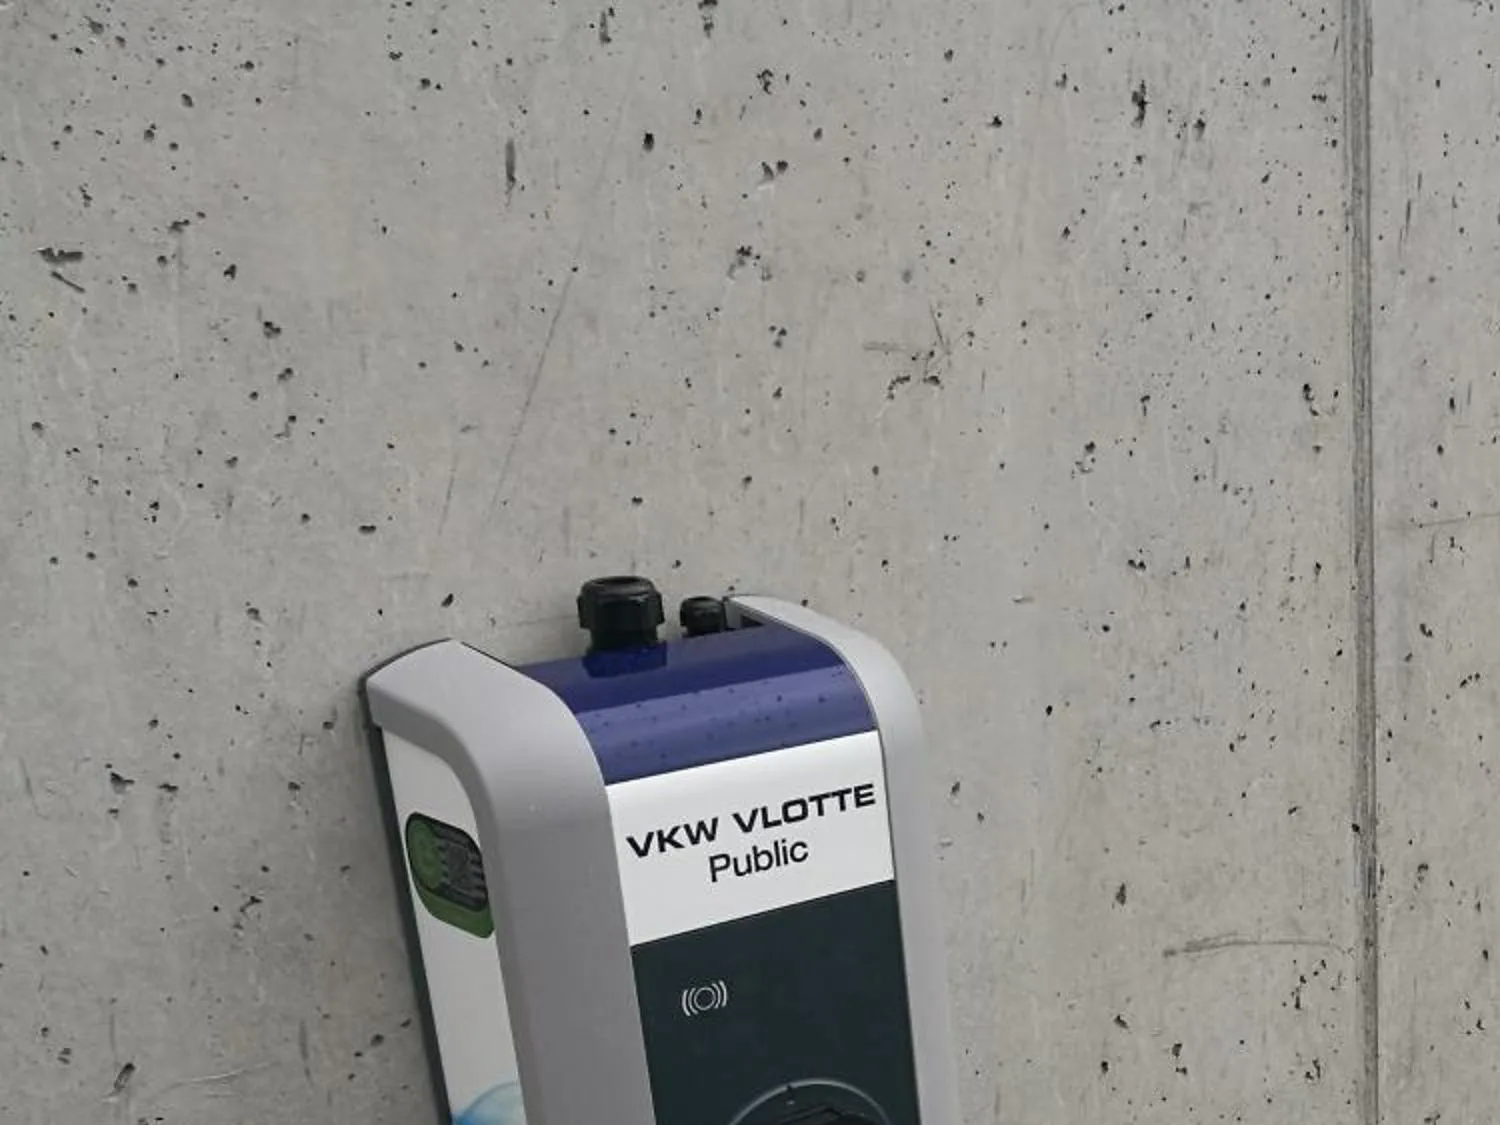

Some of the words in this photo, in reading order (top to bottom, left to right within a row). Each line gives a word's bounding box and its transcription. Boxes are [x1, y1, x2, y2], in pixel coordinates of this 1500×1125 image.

[625, 816, 720, 859] VKW
[732, 783, 877, 834] VLOTTE
[708, 838, 809, 883] Public
